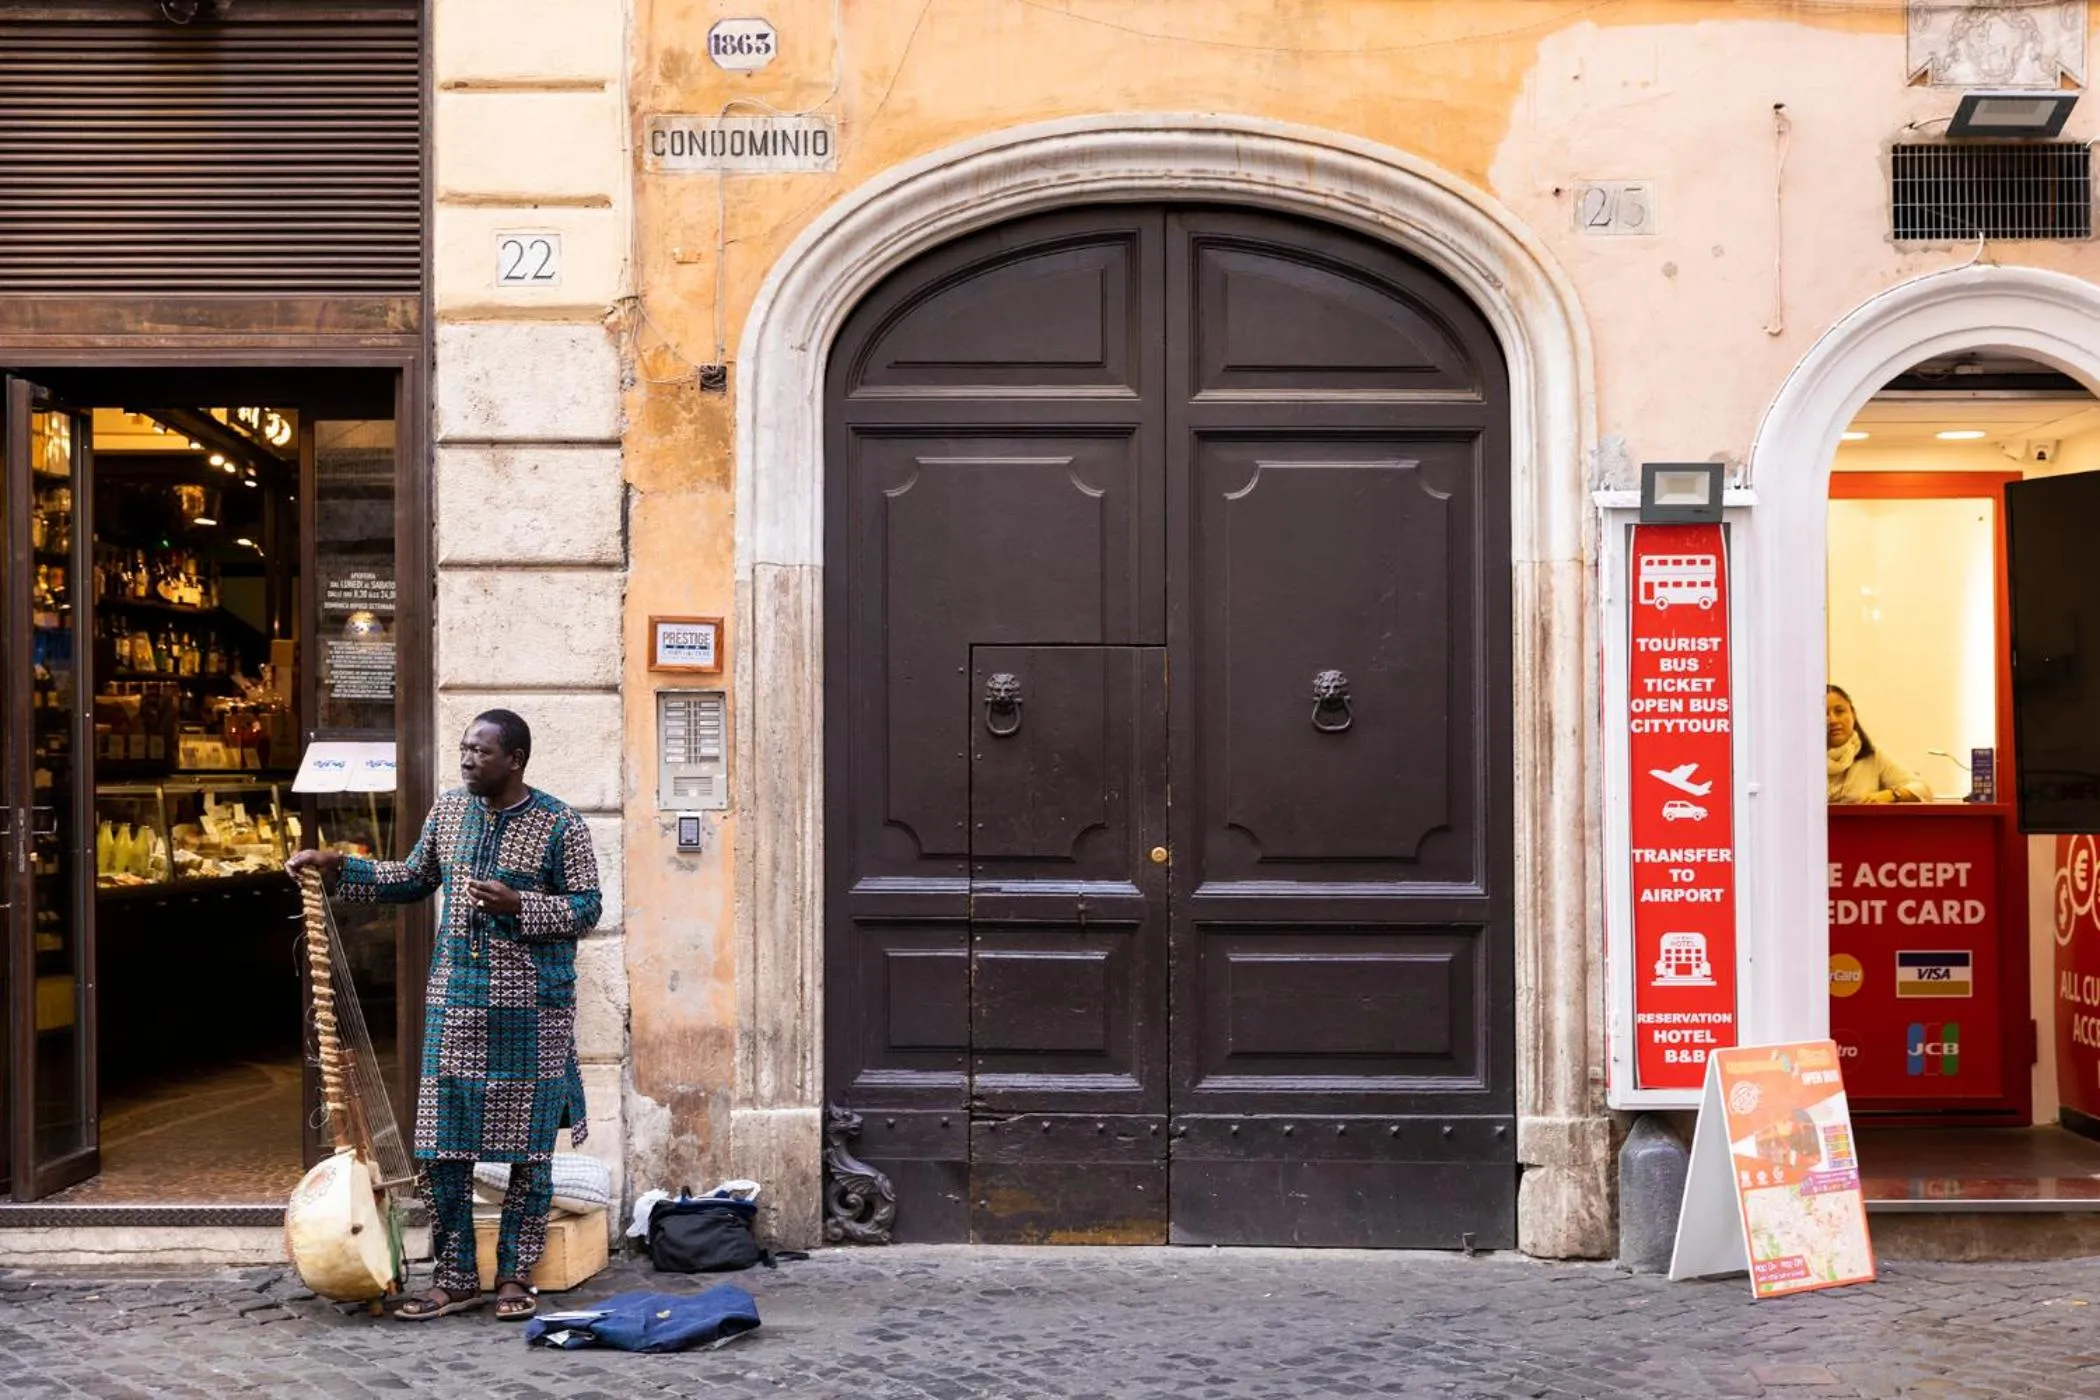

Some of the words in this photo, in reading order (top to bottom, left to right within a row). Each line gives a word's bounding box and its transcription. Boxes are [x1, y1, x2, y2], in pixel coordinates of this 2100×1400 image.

[651, 129, 829, 157] CONDOMINIO
[502, 239, 556, 280] 22
[662, 631, 710, 645] PRESTIGE
[1636, 637, 1722, 652] TOURIST
[1659, 657, 1699, 672] BUS
[1643, 678, 1715, 692] TICKET
[1631, 698, 1684, 713] OPEN
[1689, 698, 1729, 713] BUS
[1631, 718, 1731, 733] CITYTOUR
[1632, 848, 1732, 863] TRANSFER
[1669, 868, 1695, 882] TO
[1853, 862, 1972, 888] ACCEPT
[1640, 888, 1724, 902] AIRPORT
[1896, 899, 1986, 925] CARD
[1916, 968, 1951, 980] VISA
[2060, 970, 2080, 1002] ALL
[1637, 1013, 1732, 1024] RESERVATION
[1653, 1029, 1717, 1044] HOTEL
[1664, 1049, 1706, 1064] B&B
[1908, 1042, 1960, 1057] JCB
